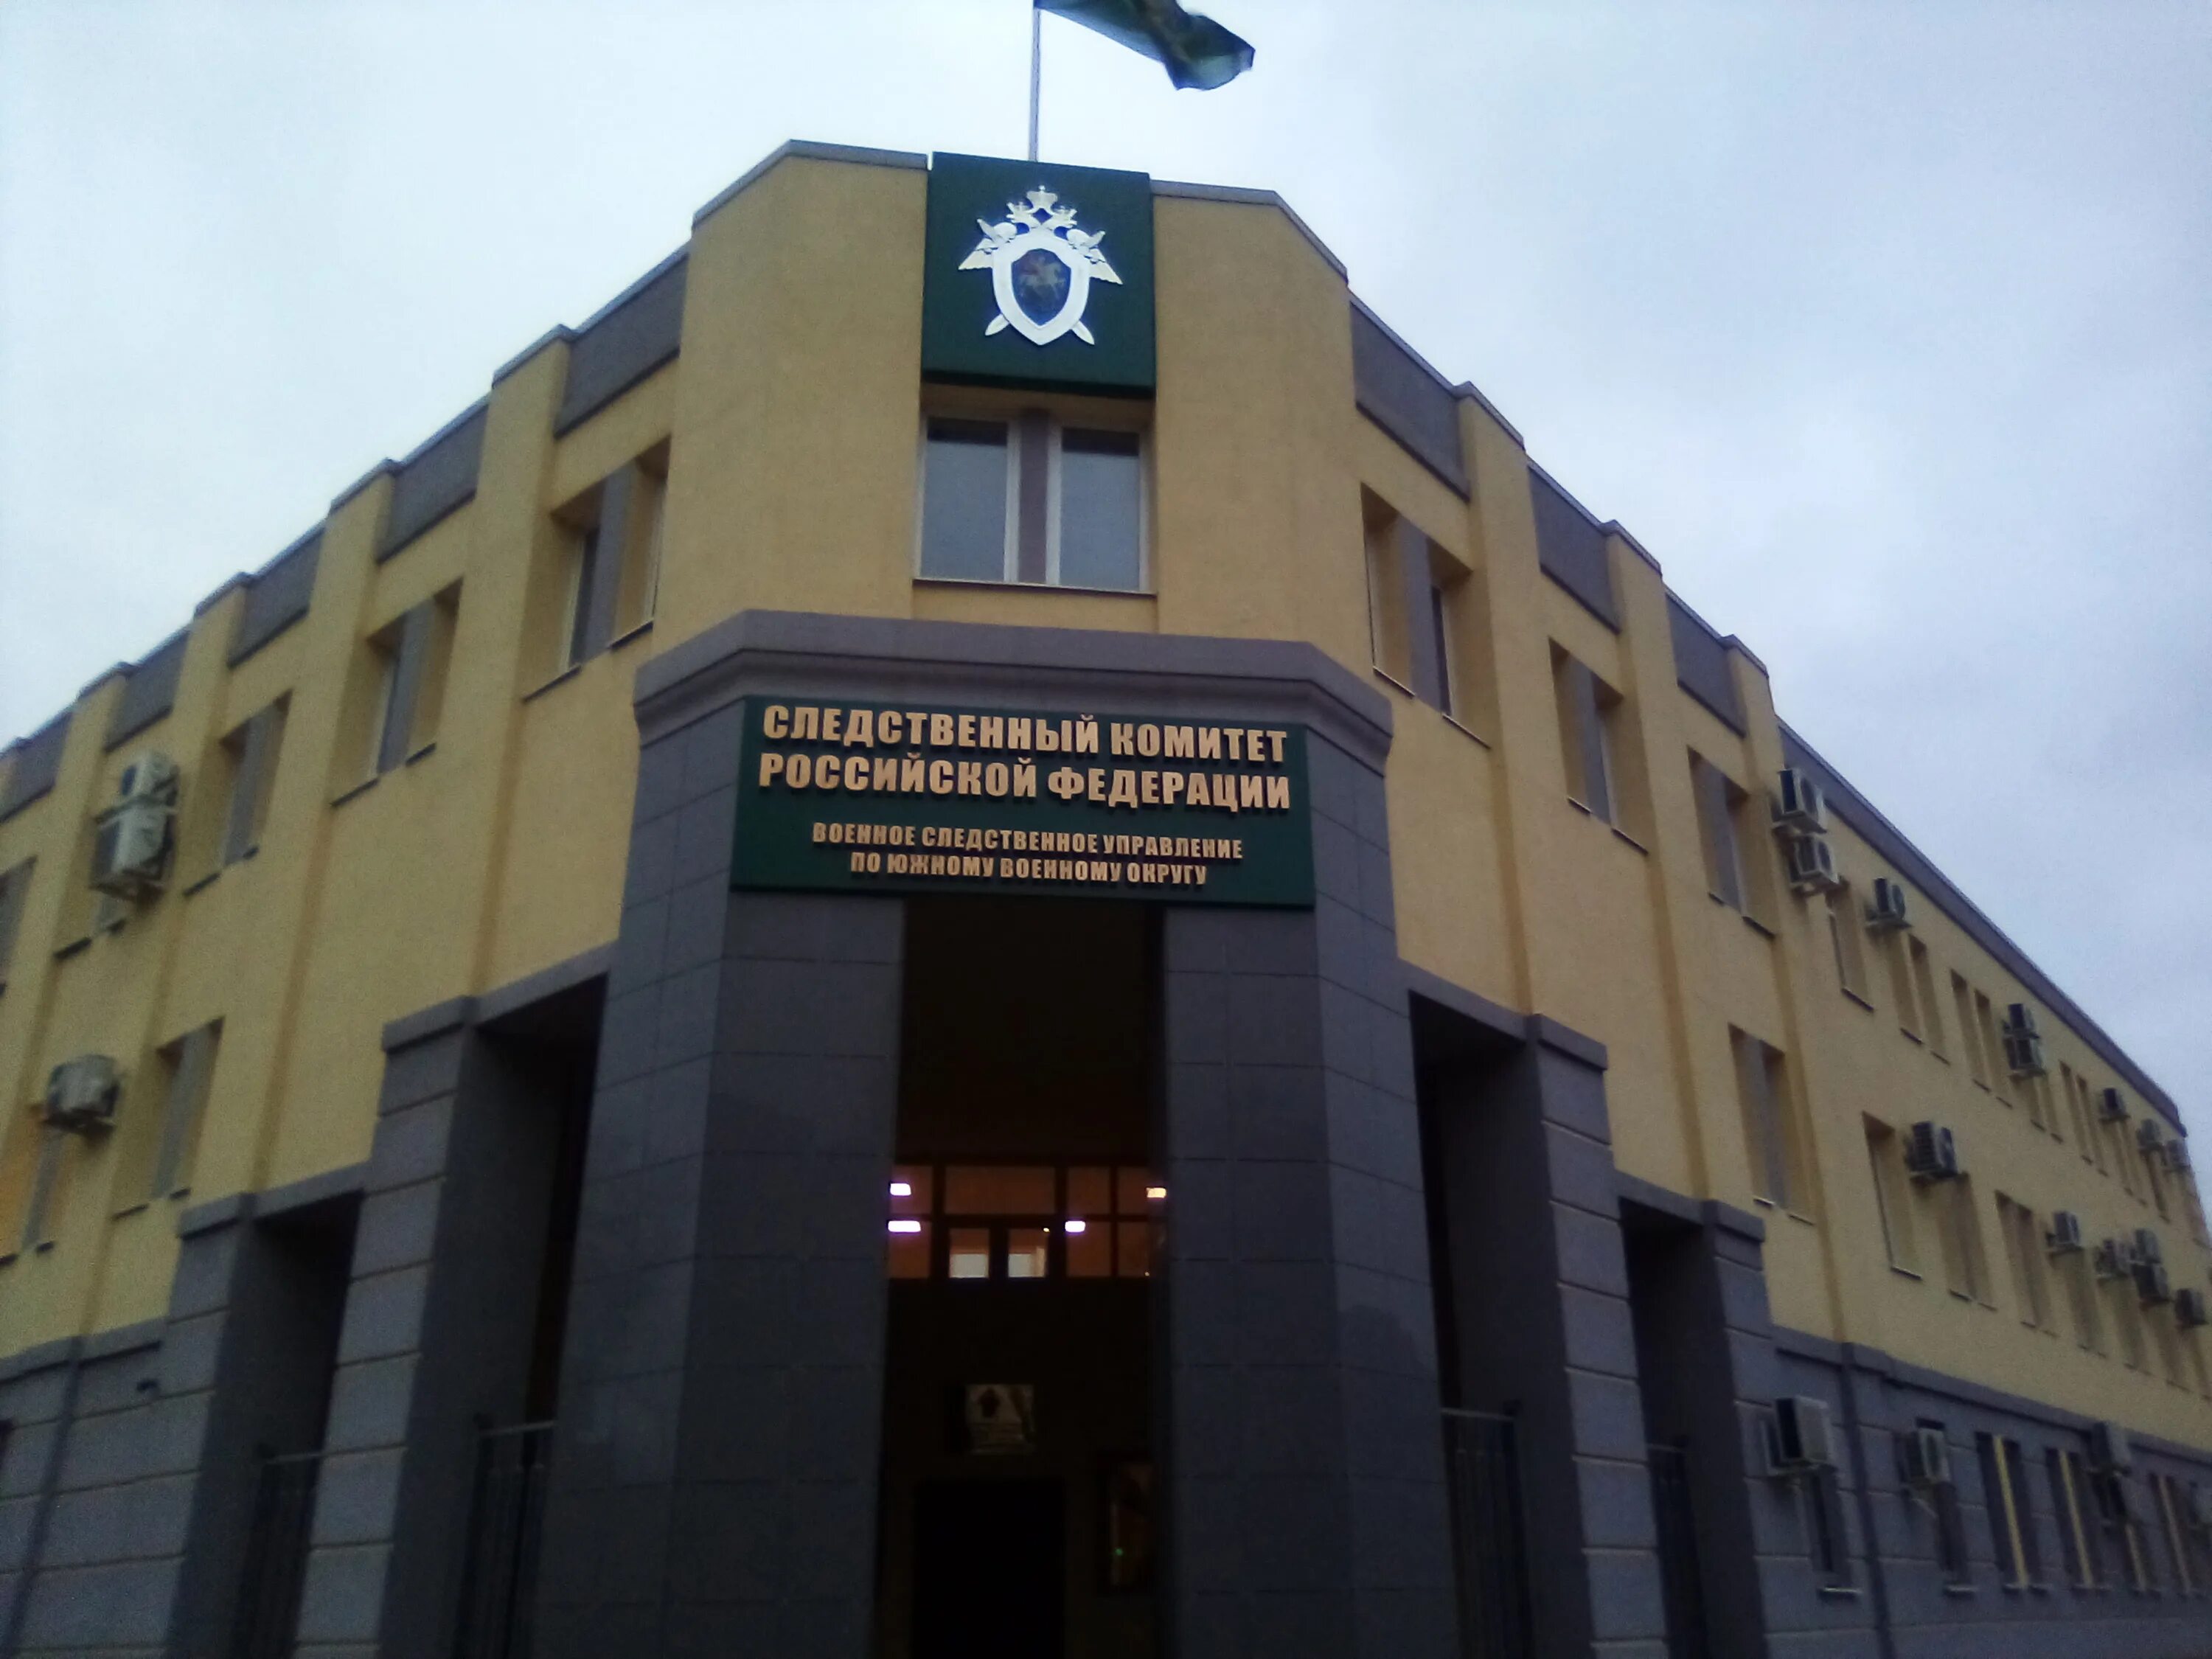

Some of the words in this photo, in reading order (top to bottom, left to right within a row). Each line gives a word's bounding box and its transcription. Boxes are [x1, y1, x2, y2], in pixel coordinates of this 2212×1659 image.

[763, 705, 1099, 754] СЛЕДСТВЕННЫЙ
[1110, 723, 1287, 762] КОМИТЕТ
[759, 752, 1037, 797] РОССИЙСКОЙ
[1048, 766, 1290, 813] ФЕДЕРАЦИИ
[813, 822, 915, 846] ВОЕННОЕ
[922, 827, 1098, 853] СЛЕДСТВЕННОЕ
[1102, 835, 1243, 859] УПРАВЛЕНИЕ
[851, 852, 881, 873] ПО
[887, 853, 994, 877] ЮЖНОМУ
[1000, 858, 1121, 882] ВОЕННОМУ
[1127, 862, 1207, 885] ОКРУГУ
